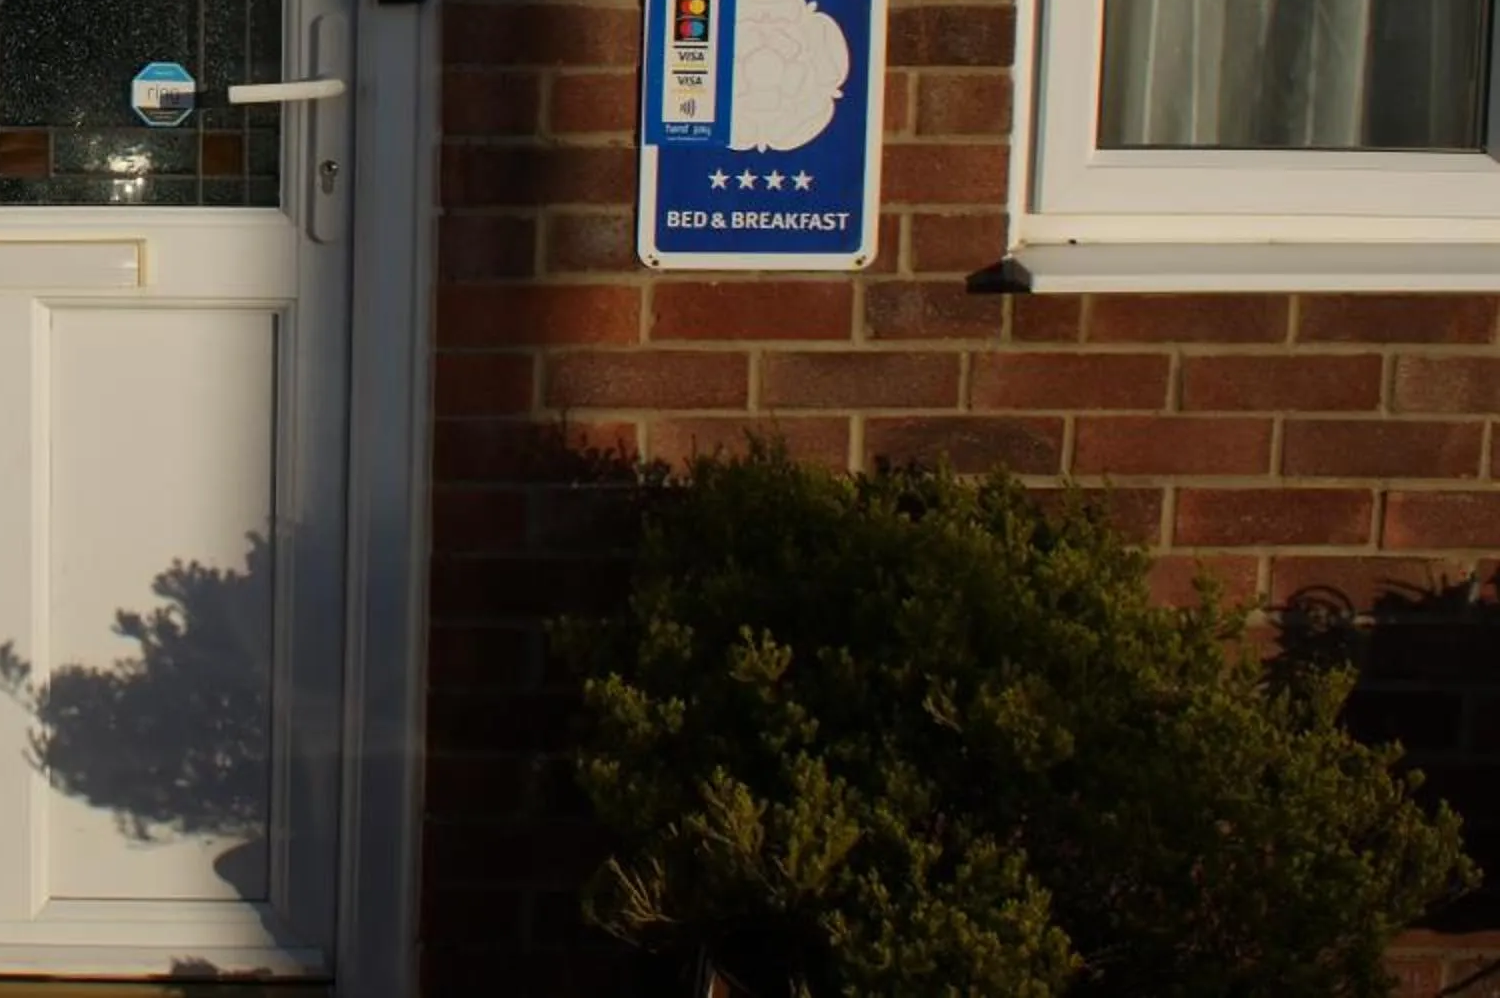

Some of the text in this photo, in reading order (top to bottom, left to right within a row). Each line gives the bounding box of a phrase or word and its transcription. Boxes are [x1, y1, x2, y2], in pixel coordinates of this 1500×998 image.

[677, 51, 705, 61] VISA
[676, 75, 703, 85] VISA
[667, 211, 850, 231] BED & BREAKFAST
